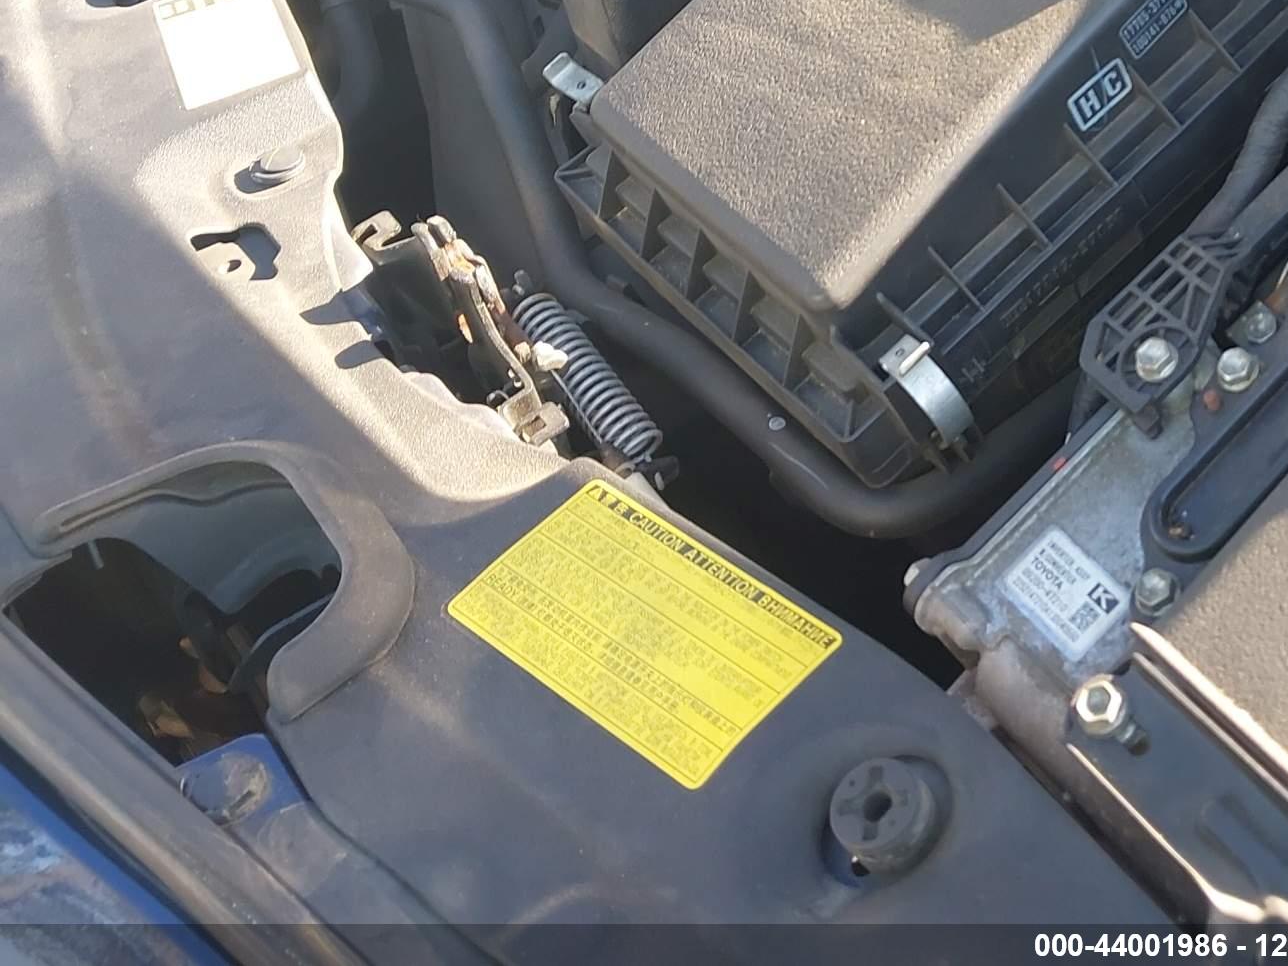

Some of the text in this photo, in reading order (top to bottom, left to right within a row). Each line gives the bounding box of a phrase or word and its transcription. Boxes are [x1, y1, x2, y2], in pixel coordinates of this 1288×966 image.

[1078, 72, 1123, 120] H/C
[628, 511, 834, 649] CAUTION ATTENTION ВНИМАНИЕ
[1031, 556, 1064, 590] TOYOTA
[1090, 584, 1113, 611] K
